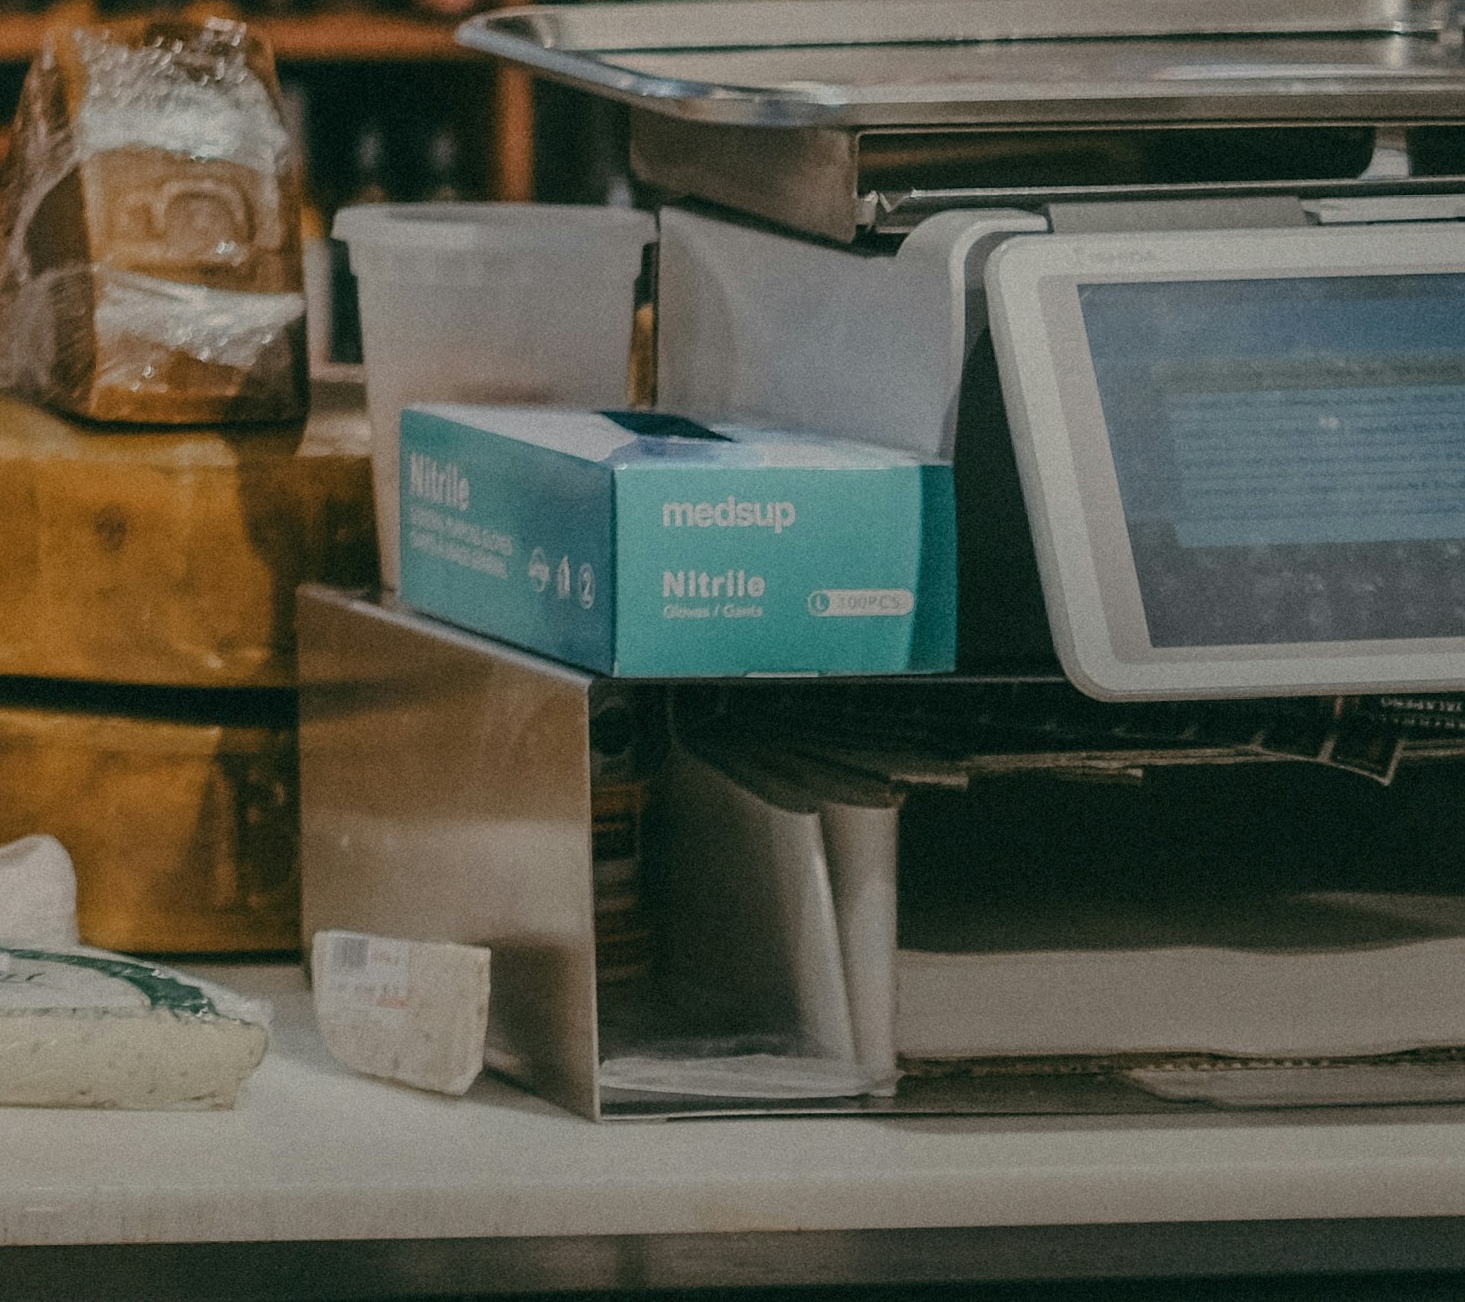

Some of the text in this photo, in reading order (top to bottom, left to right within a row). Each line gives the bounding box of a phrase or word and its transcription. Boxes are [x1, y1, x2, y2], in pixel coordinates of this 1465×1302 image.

[410, 452, 470, 511] Nitrile
[662, 495, 796, 534] medsup
[662, 569, 766, 598] Nitrile
